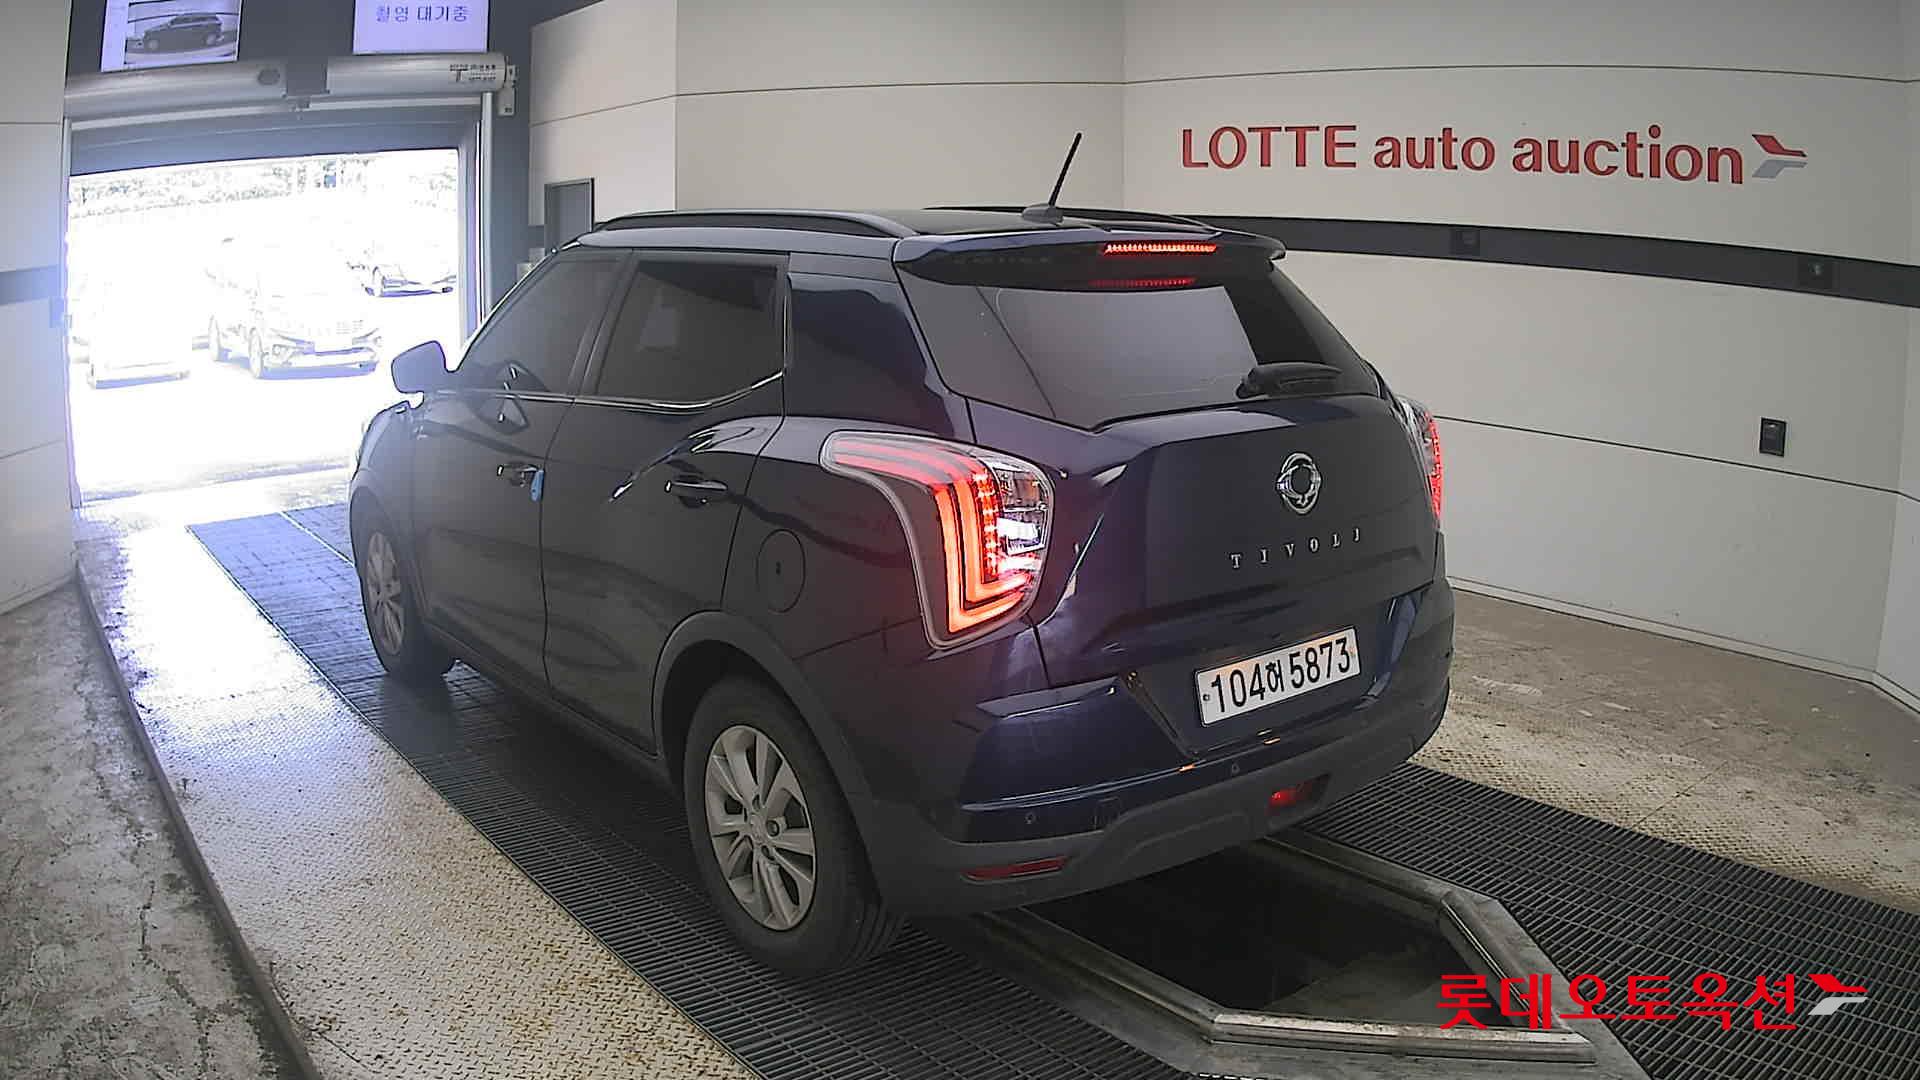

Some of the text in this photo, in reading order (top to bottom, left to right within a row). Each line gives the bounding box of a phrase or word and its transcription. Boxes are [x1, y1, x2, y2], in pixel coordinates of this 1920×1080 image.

[417, 6, 467, 22] 대기중
[1181, 124, 1743, 184] LOTTE auto auction
[1230, 527, 1361, 569] TIVOLI
